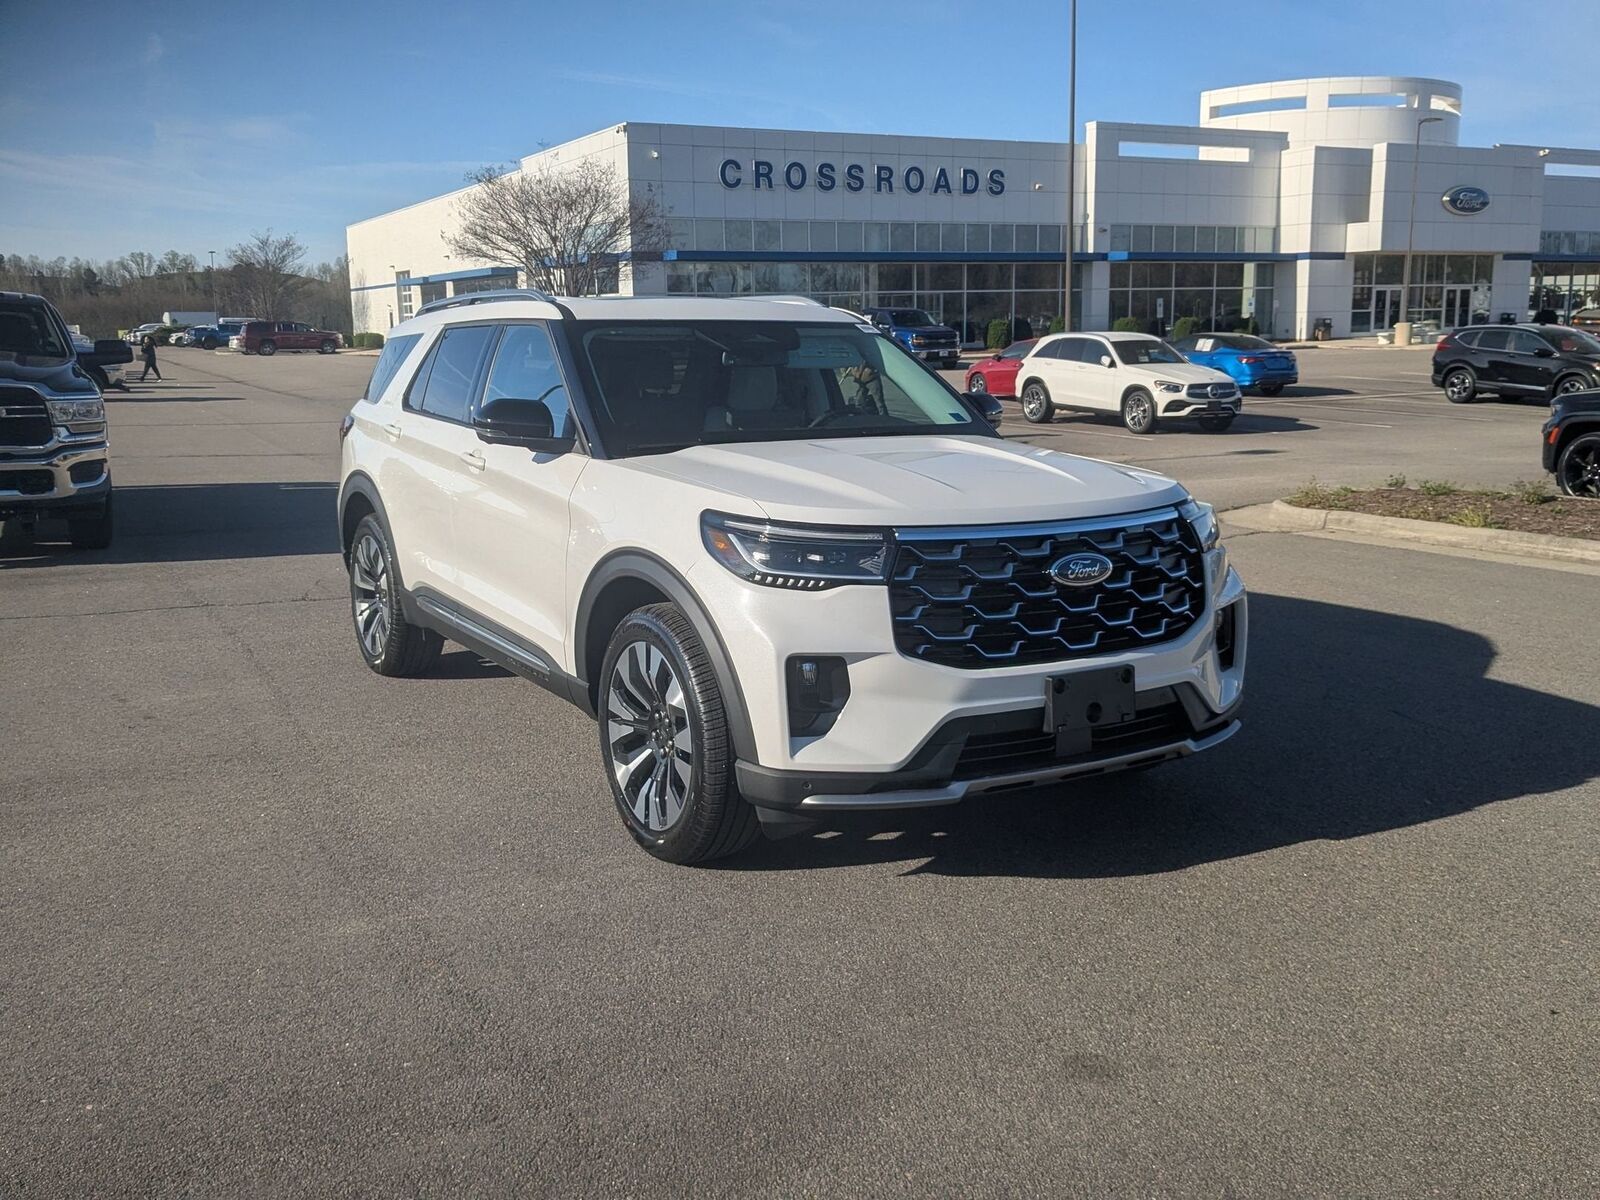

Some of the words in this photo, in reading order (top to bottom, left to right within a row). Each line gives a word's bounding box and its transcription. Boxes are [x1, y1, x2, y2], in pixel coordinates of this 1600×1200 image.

[719, 159, 1006, 196] CROSSROADS
[1456, 191, 1483, 208] Ford
[1067, 560, 1100, 578] Ford
